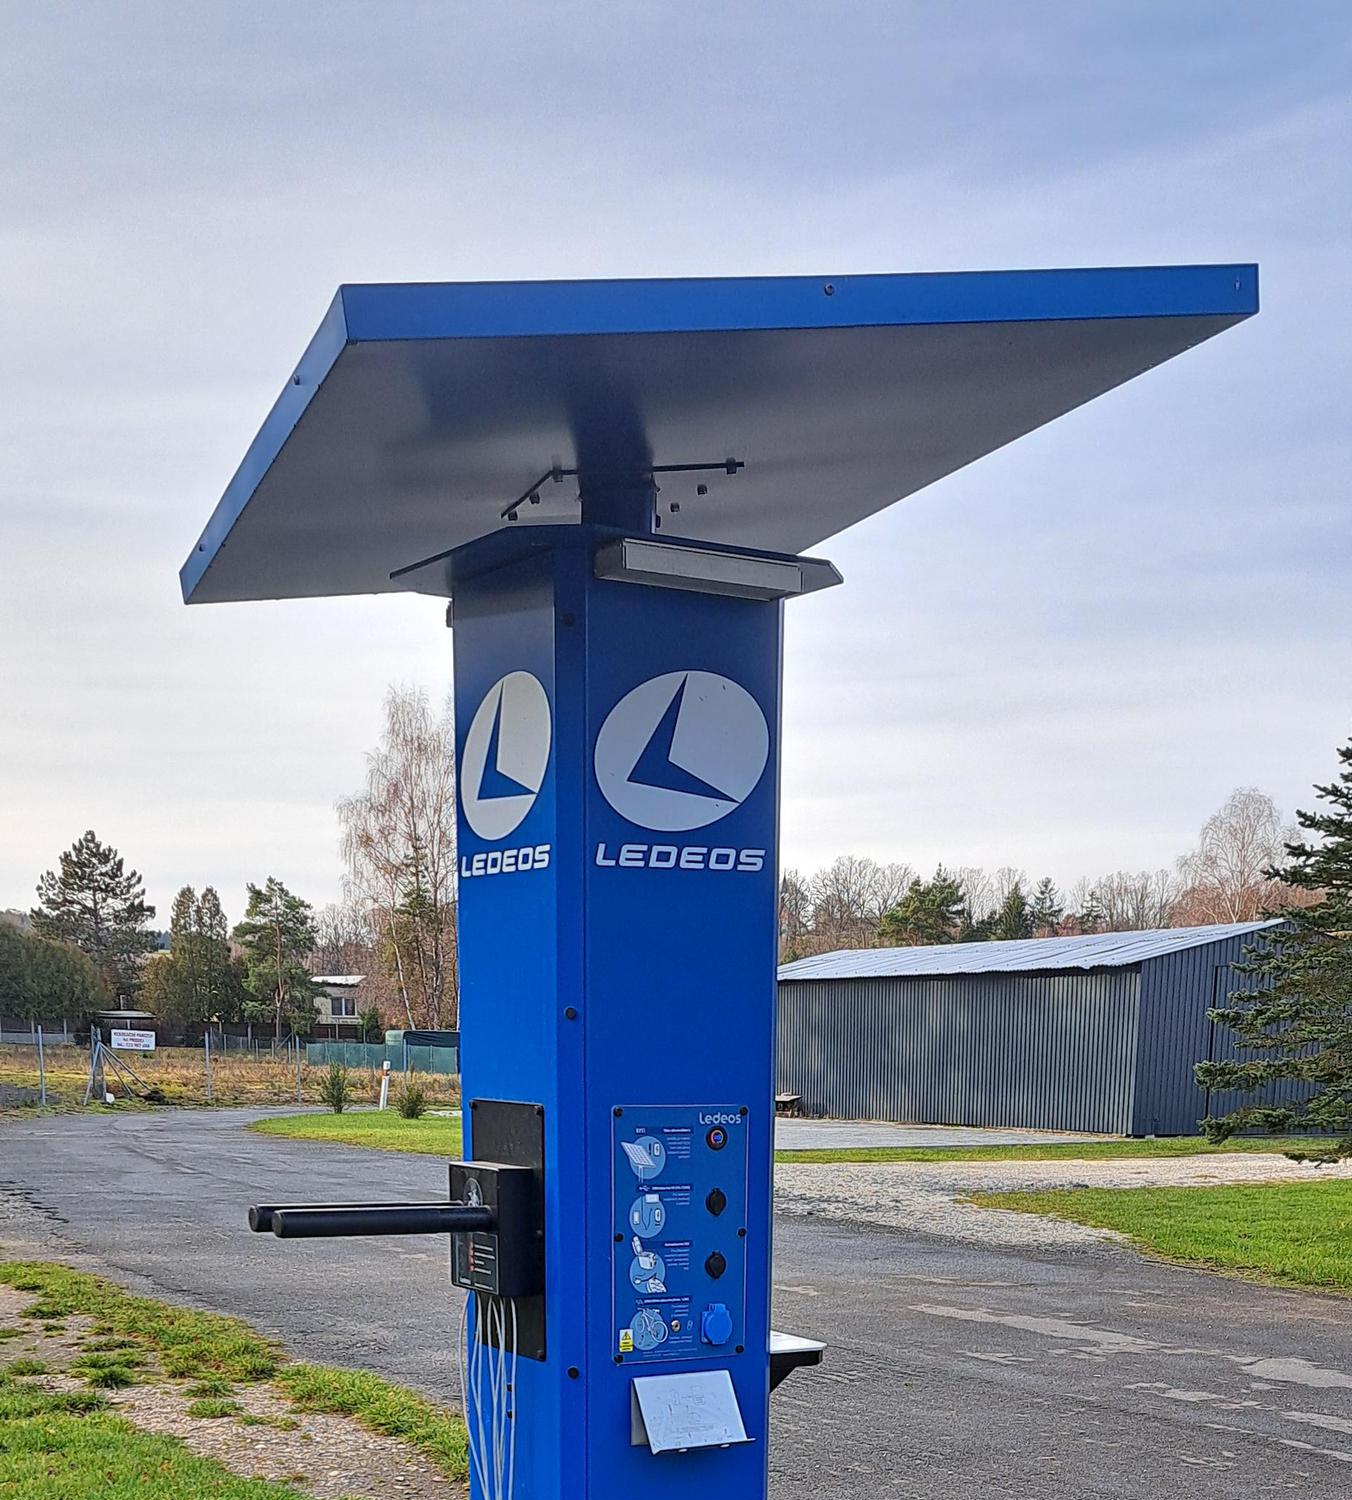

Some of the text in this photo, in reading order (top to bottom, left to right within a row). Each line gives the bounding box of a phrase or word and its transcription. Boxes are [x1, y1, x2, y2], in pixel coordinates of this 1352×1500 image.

[461, 844, 551, 877] LEDEOS
[595, 842, 766, 872] LEDEOS
[699, 1111, 742, 1125] Ledeos
